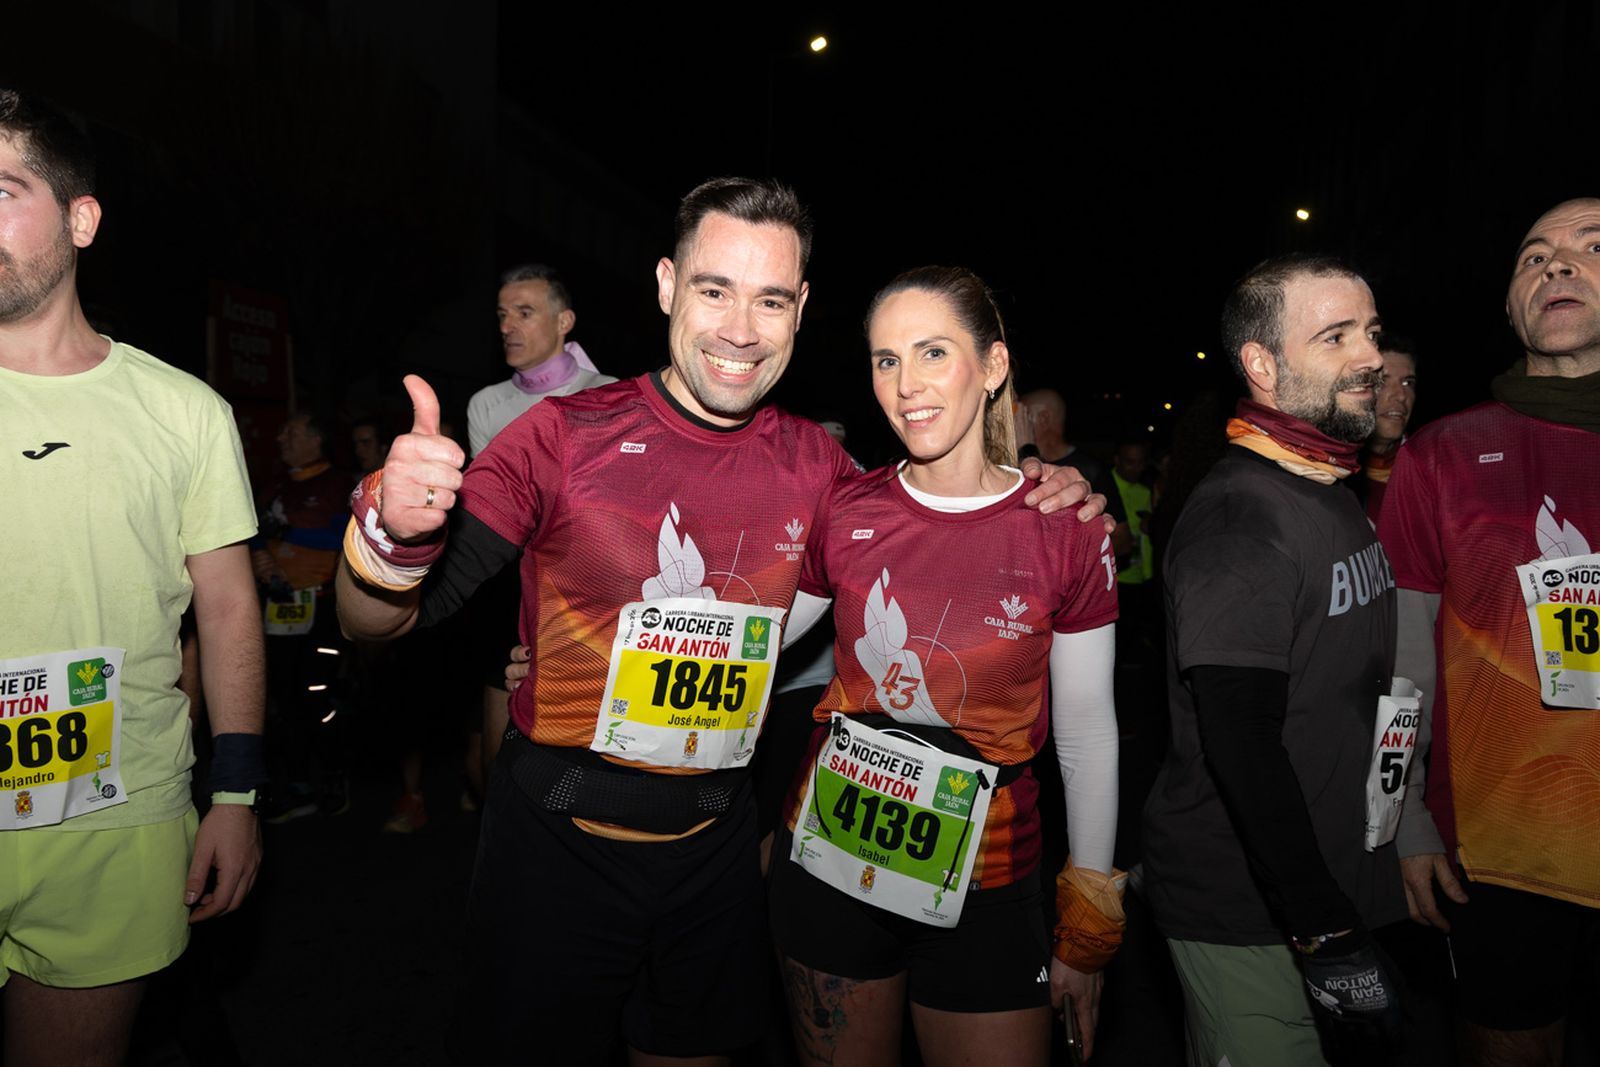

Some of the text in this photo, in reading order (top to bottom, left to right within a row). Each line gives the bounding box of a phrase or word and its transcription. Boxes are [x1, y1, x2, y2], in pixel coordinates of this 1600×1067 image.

[1548, 587, 1584, 603] SAN
[1586, 589, 1600, 605] A
[663, 617, 735, 637] NOCHE DE
[984, 616, 1005, 628] CAJA
[1553, 607, 1600, 655] 13
[637, 633, 730, 659] SAN ANTÓN
[23, 674, 48, 692] DE
[650, 659, 748, 712] 1845
[881, 663, 920, 710] 43
[668, 714, 721, 729] José Angel
[849, 743, 901, 773] NOCHE
[900, 761, 924, 781] DE
[829, 754, 918, 802] SAN ANTÓN
[832, 783, 941, 861] 4139
[858, 845, 890, 866] Isabel
[1351, 983, 1385, 1000] SAN
